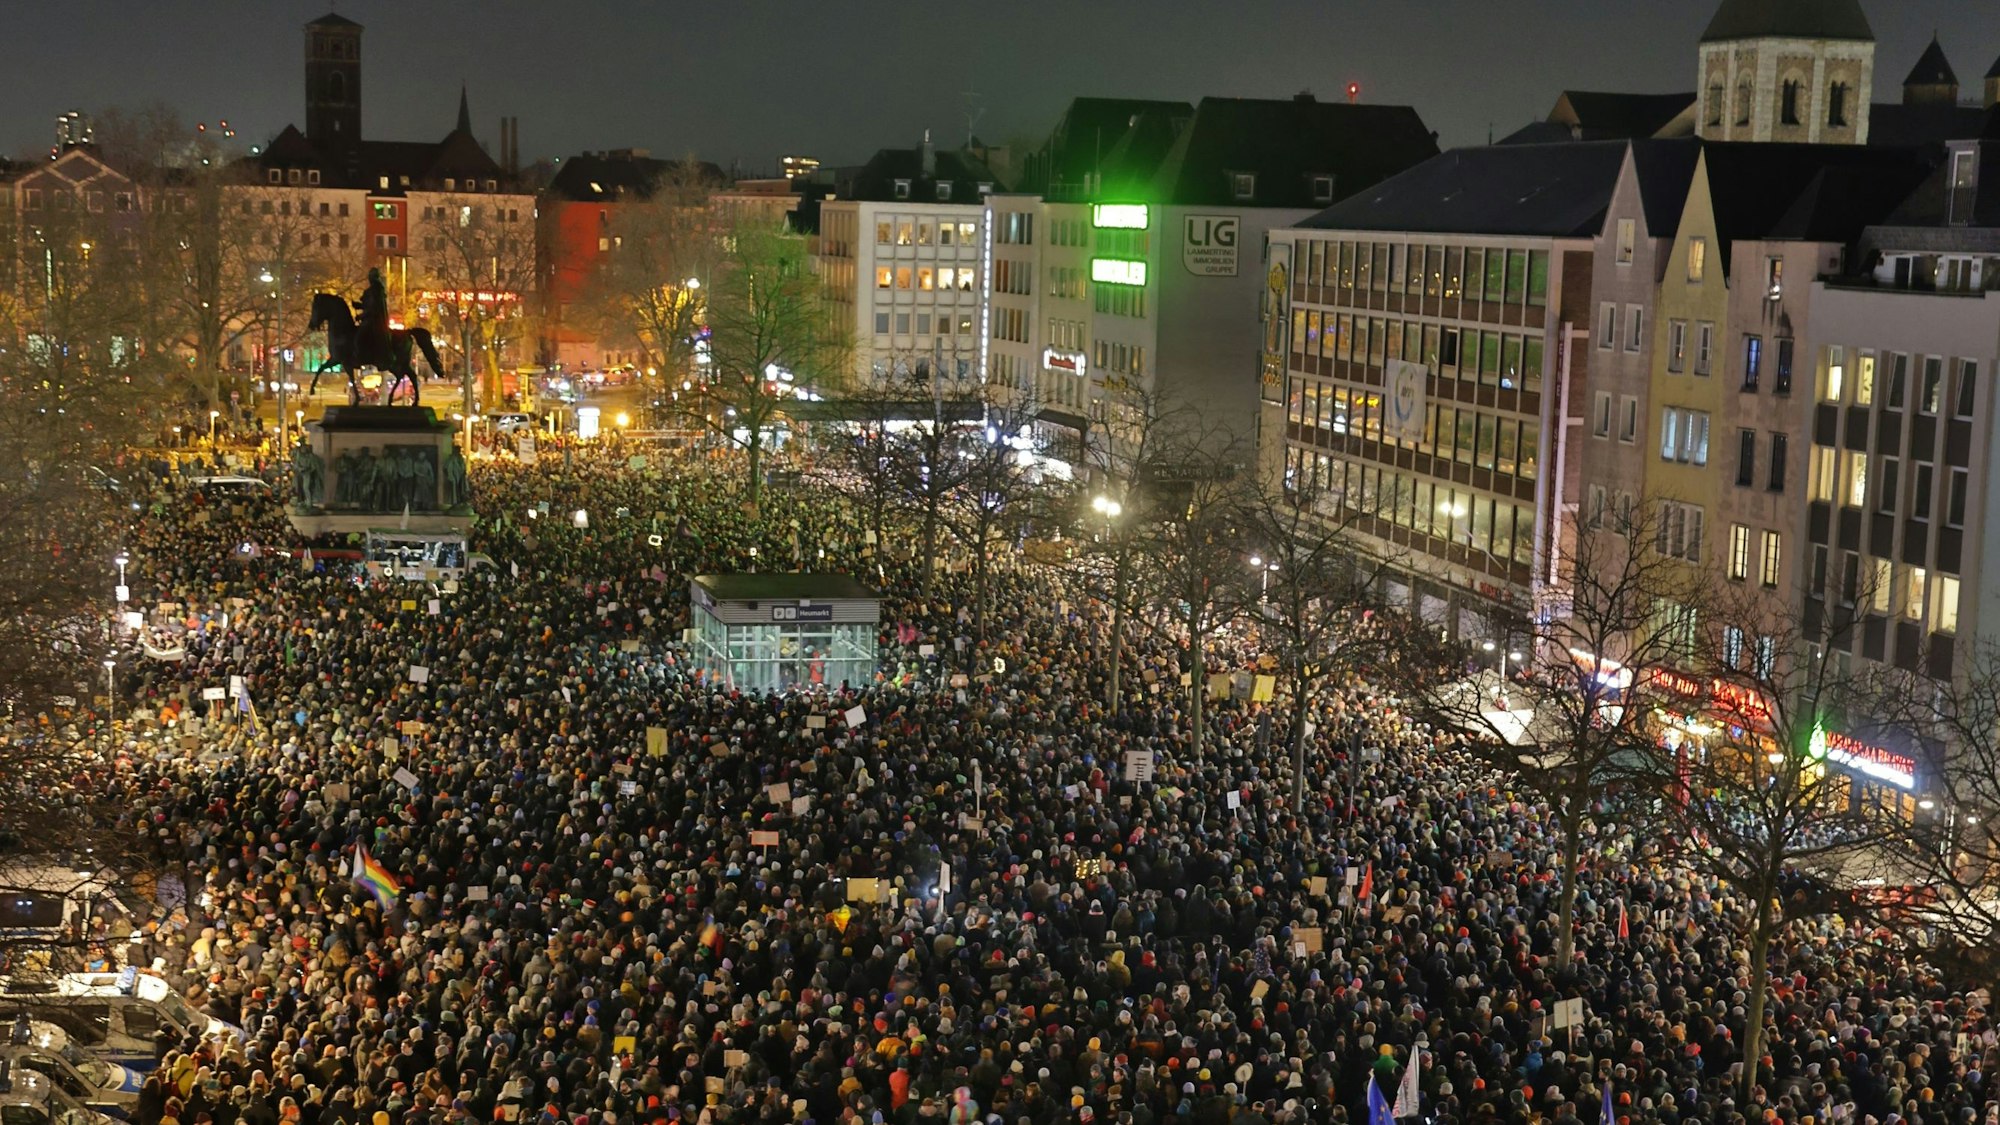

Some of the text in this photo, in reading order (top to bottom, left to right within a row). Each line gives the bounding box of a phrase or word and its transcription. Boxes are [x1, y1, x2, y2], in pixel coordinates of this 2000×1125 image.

[1188, 219, 1235, 246] LIG
[1187, 248, 1234, 256] LAMMERTING
[1193, 257, 1234, 265] IMMOBILIEN
[1205, 266, 1234, 274] GRUPPE
